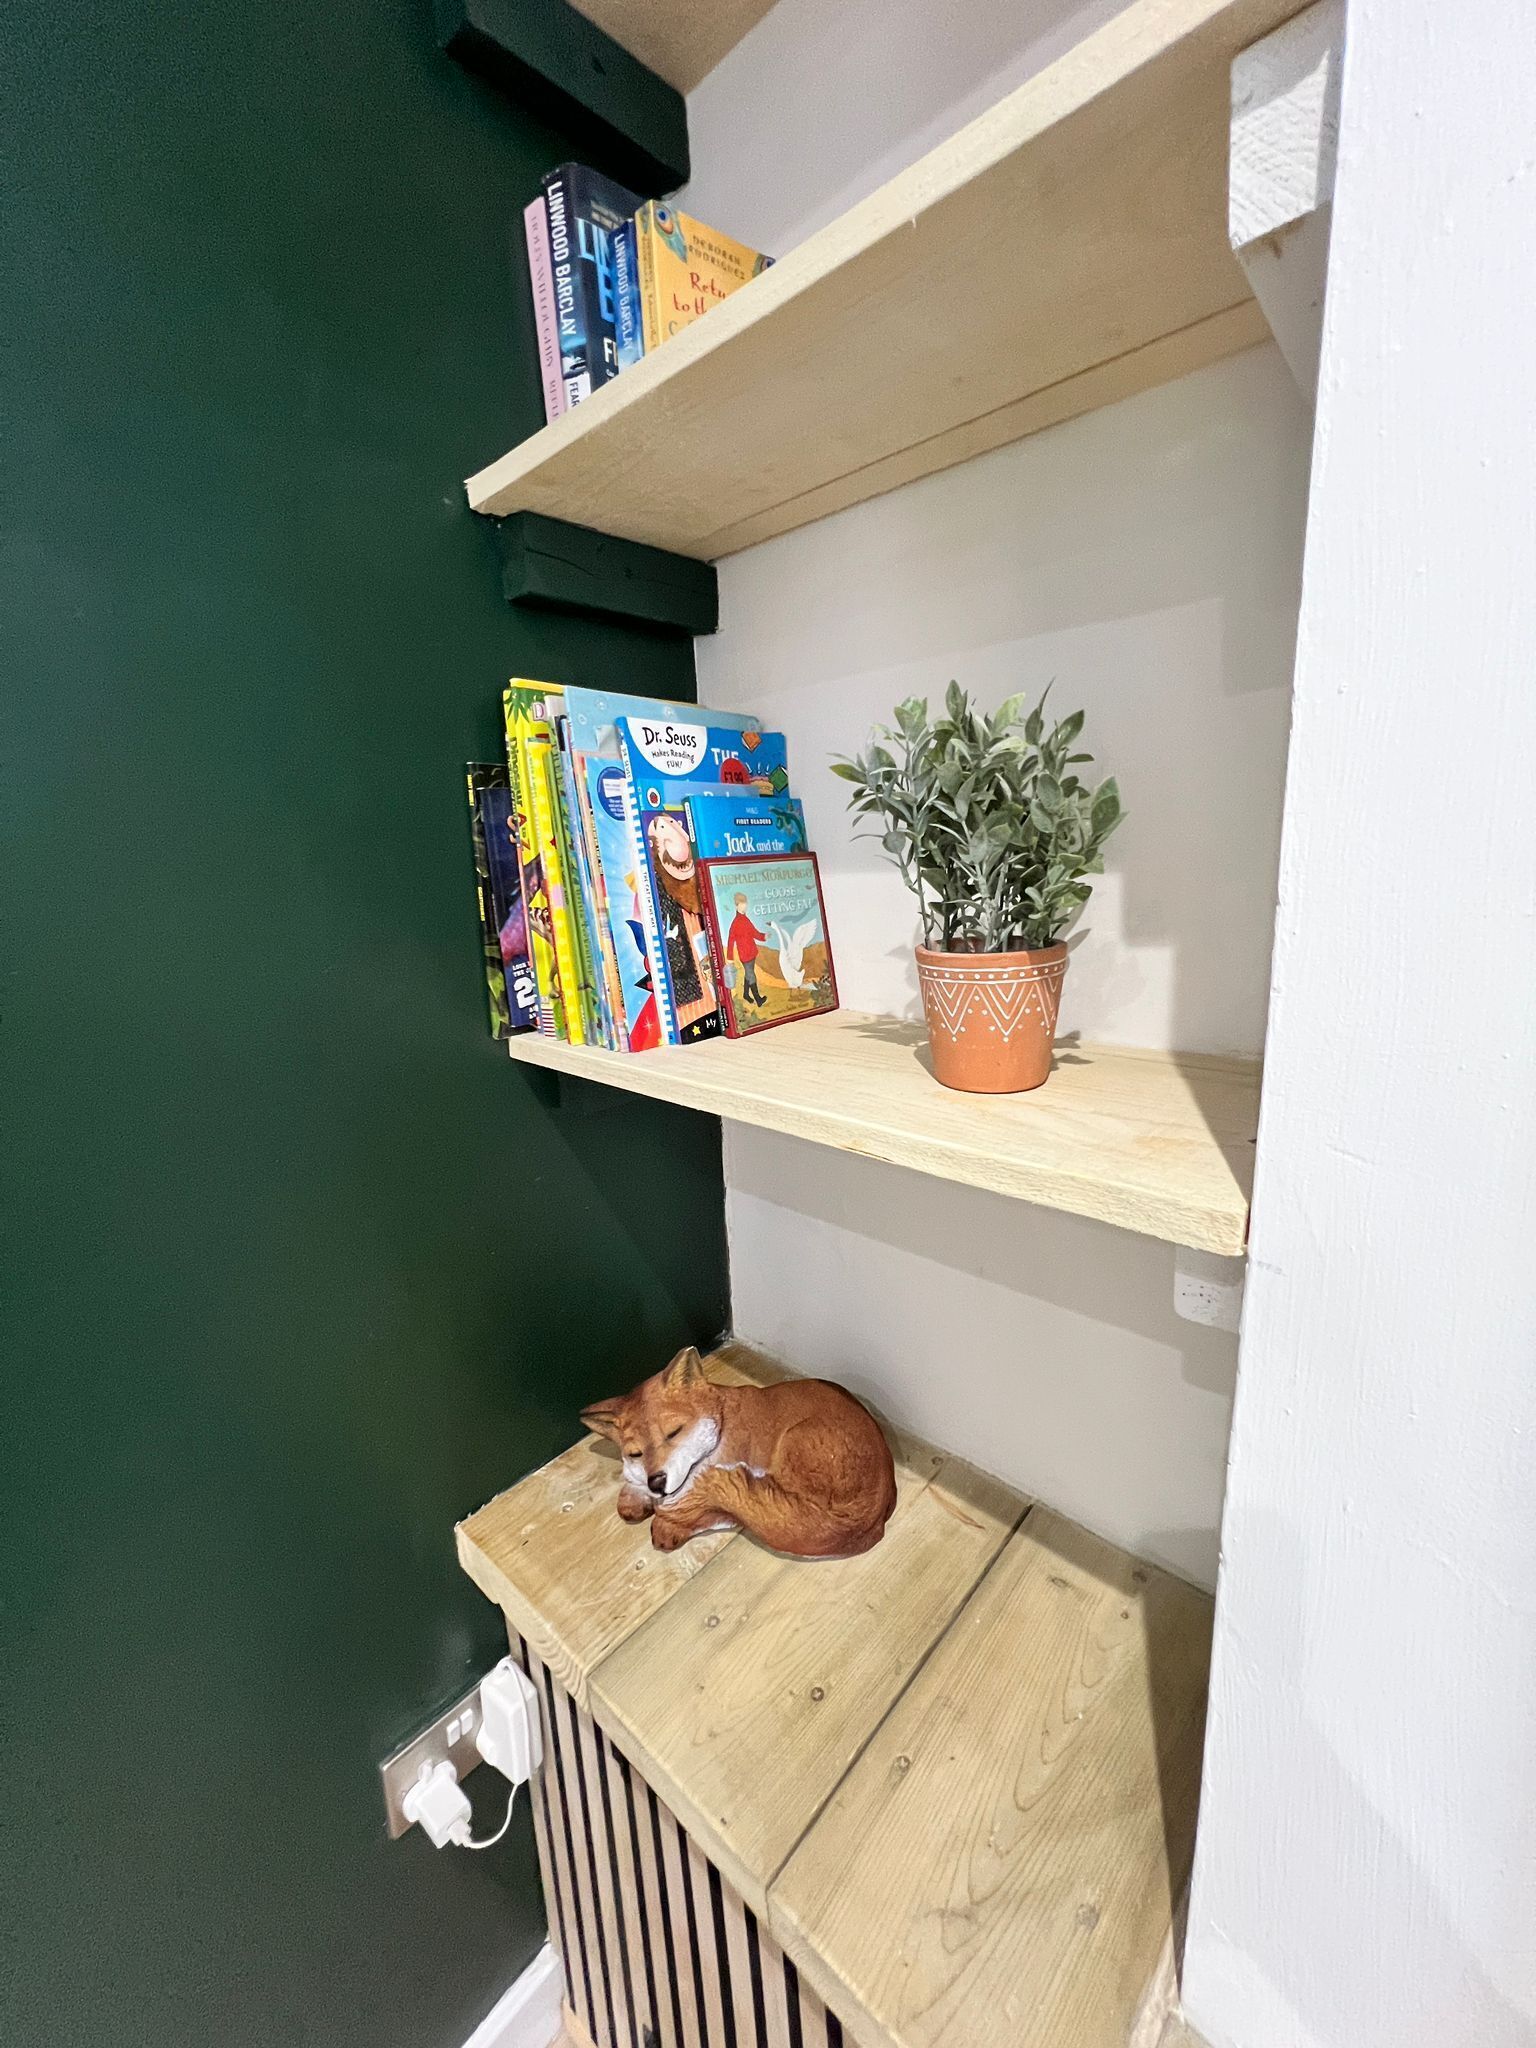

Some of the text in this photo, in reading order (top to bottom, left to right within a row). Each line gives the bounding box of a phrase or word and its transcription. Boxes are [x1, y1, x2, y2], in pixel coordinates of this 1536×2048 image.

[547, 181, 577, 335] LINWOOD BARCLAY
[692, 234, 742, 265] DEBORAH
[688, 244, 746, 280] RODRIGUEZ
[614, 233, 634, 350] LINWOOD BARCLAY
[673, 292, 690, 311] to
[569, 381, 580, 408] FEAR
[642, 726, 697, 748] Dr. Seuss
[651, 749, 695, 764] Makes Reading
[666, 760, 683, 769] FUN!
[711, 748, 739, 765] THE
[510, 735, 523, 807] Dinosaur
[723, 831, 784, 856] Jack and the
[715, 871, 759, 886] MICHAEL
[762, 867, 814, 882] MORPURGO
[765, 886, 797, 898] GOOSE
[753, 901, 796, 915] GETTING
[706, 1019, 717, 1028] My
